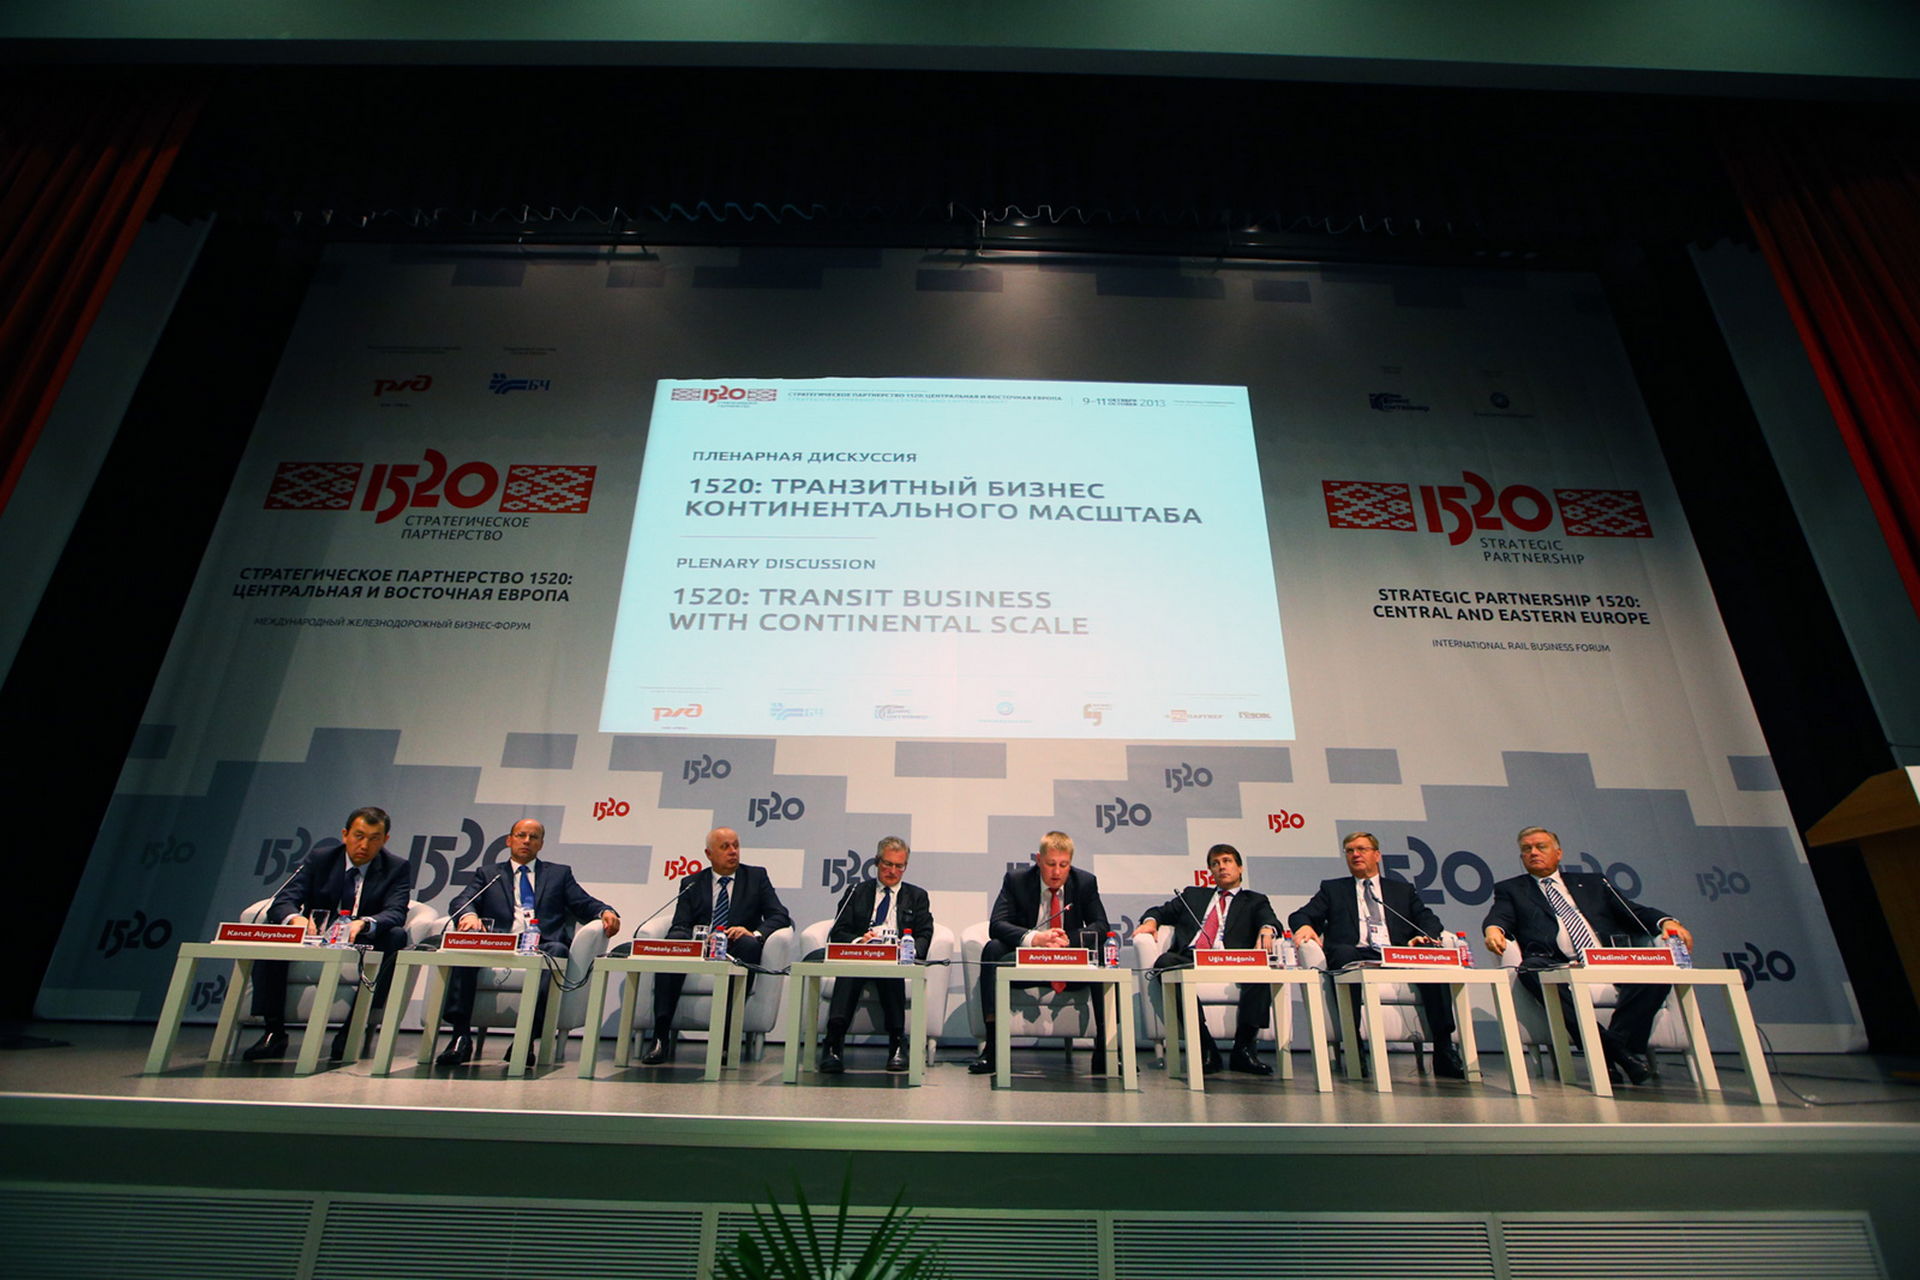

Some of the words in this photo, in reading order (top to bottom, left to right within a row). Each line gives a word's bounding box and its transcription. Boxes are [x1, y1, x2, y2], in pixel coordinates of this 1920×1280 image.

[703, 385, 746, 403] 1520
[1140, 398, 1166, 408] 2013
[693, 451, 802, 462] ПЛЕНАРНАЯ
[807, 452, 917, 463] ДИСКУССИЯ
[360, 448, 499, 524] 1520
[690, 477, 762, 494] 1520:
[771, 476, 977, 496] ТРАНЗИТНЫЙ
[988, 481, 1105, 499] БИЗНЕС
[685, 500, 1018, 520] КОНТИНЕНТАЛЬНОГО
[1029, 504, 1203, 524] МАСШТАБА
[1420, 470, 1554, 546] 1520
[404, 515, 530, 528] СТРАТЕГИЧЕСКОЕ
[401, 528, 503, 541] ПАРТНЕРСТВО
[1480, 537, 1563, 551] STRATEGIC
[676, 557, 760, 569] PLENARY
[766, 558, 877, 570] DISCUSSION
[1484, 551, 1585, 565] PARTNERSHIP
[239, 568, 392, 582] СТРАТЕГИЧЕСКОЕ
[396, 569, 525, 585] ПАРТНЕРСТВО
[529, 571, 573, 585] 1520:
[233, 583, 362, 600] ЦЕНТРАЛЬНАЯ
[366, 585, 380, 599] И
[384, 586, 492, 601] ВОСТОЧНАЯ
[497, 588, 570, 602] ЕВРОПА
[673, 587, 750, 606] 1520:
[759, 588, 893, 607] TRANSIT
[903, 590, 1052, 609] BUSINESS
[1378, 588, 1470, 604] STRATEGIC
[1475, 591, 1591, 608] PARTNERSHIP
[1595, 594, 1641, 608] 1520:
[254, 616, 345, 628] МЕЖДУНАРОДНЫЙ
[346, 617, 453, 630] ЖЕЛЕЗНОДОРОЖНЫЙ
[454, 619, 531, 631] БИЗНЕС-ФОРУМ
[669, 612, 748, 631] WITH
[758, 613, 981, 633] CONTINENTAL
[990, 616, 1089, 635] SCALE
[1373, 605, 1453, 620] CENTRAL
[1456, 606, 1494, 621] AND
[1499, 608, 1577, 624] EASTERN
[1581, 610, 1651, 625] EUROPE
[1432, 638, 1506, 651] INTERNATIONAL
[1508, 641, 1529, 651] RAIL
[1530, 641, 1574, 652] BUSINESS
[1576, 643, 1611, 654] FORUM
[683, 754, 732, 785] 1520
[1165, 762, 1213, 793] 1520
[592, 797, 630, 821] 1520
[748, 791, 805, 828] 1520
[1095, 797, 1152, 833] 1520
[1268, 809, 1305, 833] 1520
[140, 834, 196, 871] 1520
[664, 856, 702, 881] 1520
[1696, 865, 1750, 901] 1520
[98, 910, 172, 959] 1520
[227, 929, 252, 937] Kanat
[254, 930, 296, 939] Alpysbaev
[480, 939, 512, 947] Morozov
[643, 945, 671, 953] Anatoly
[864, 949, 885, 957] Kynge
[1391, 953, 1417, 961] Stasys
[1419, 954, 1451, 962] Dailydka
[1723, 942, 1796, 992] 1520
[191, 974, 227, 1012] 152
